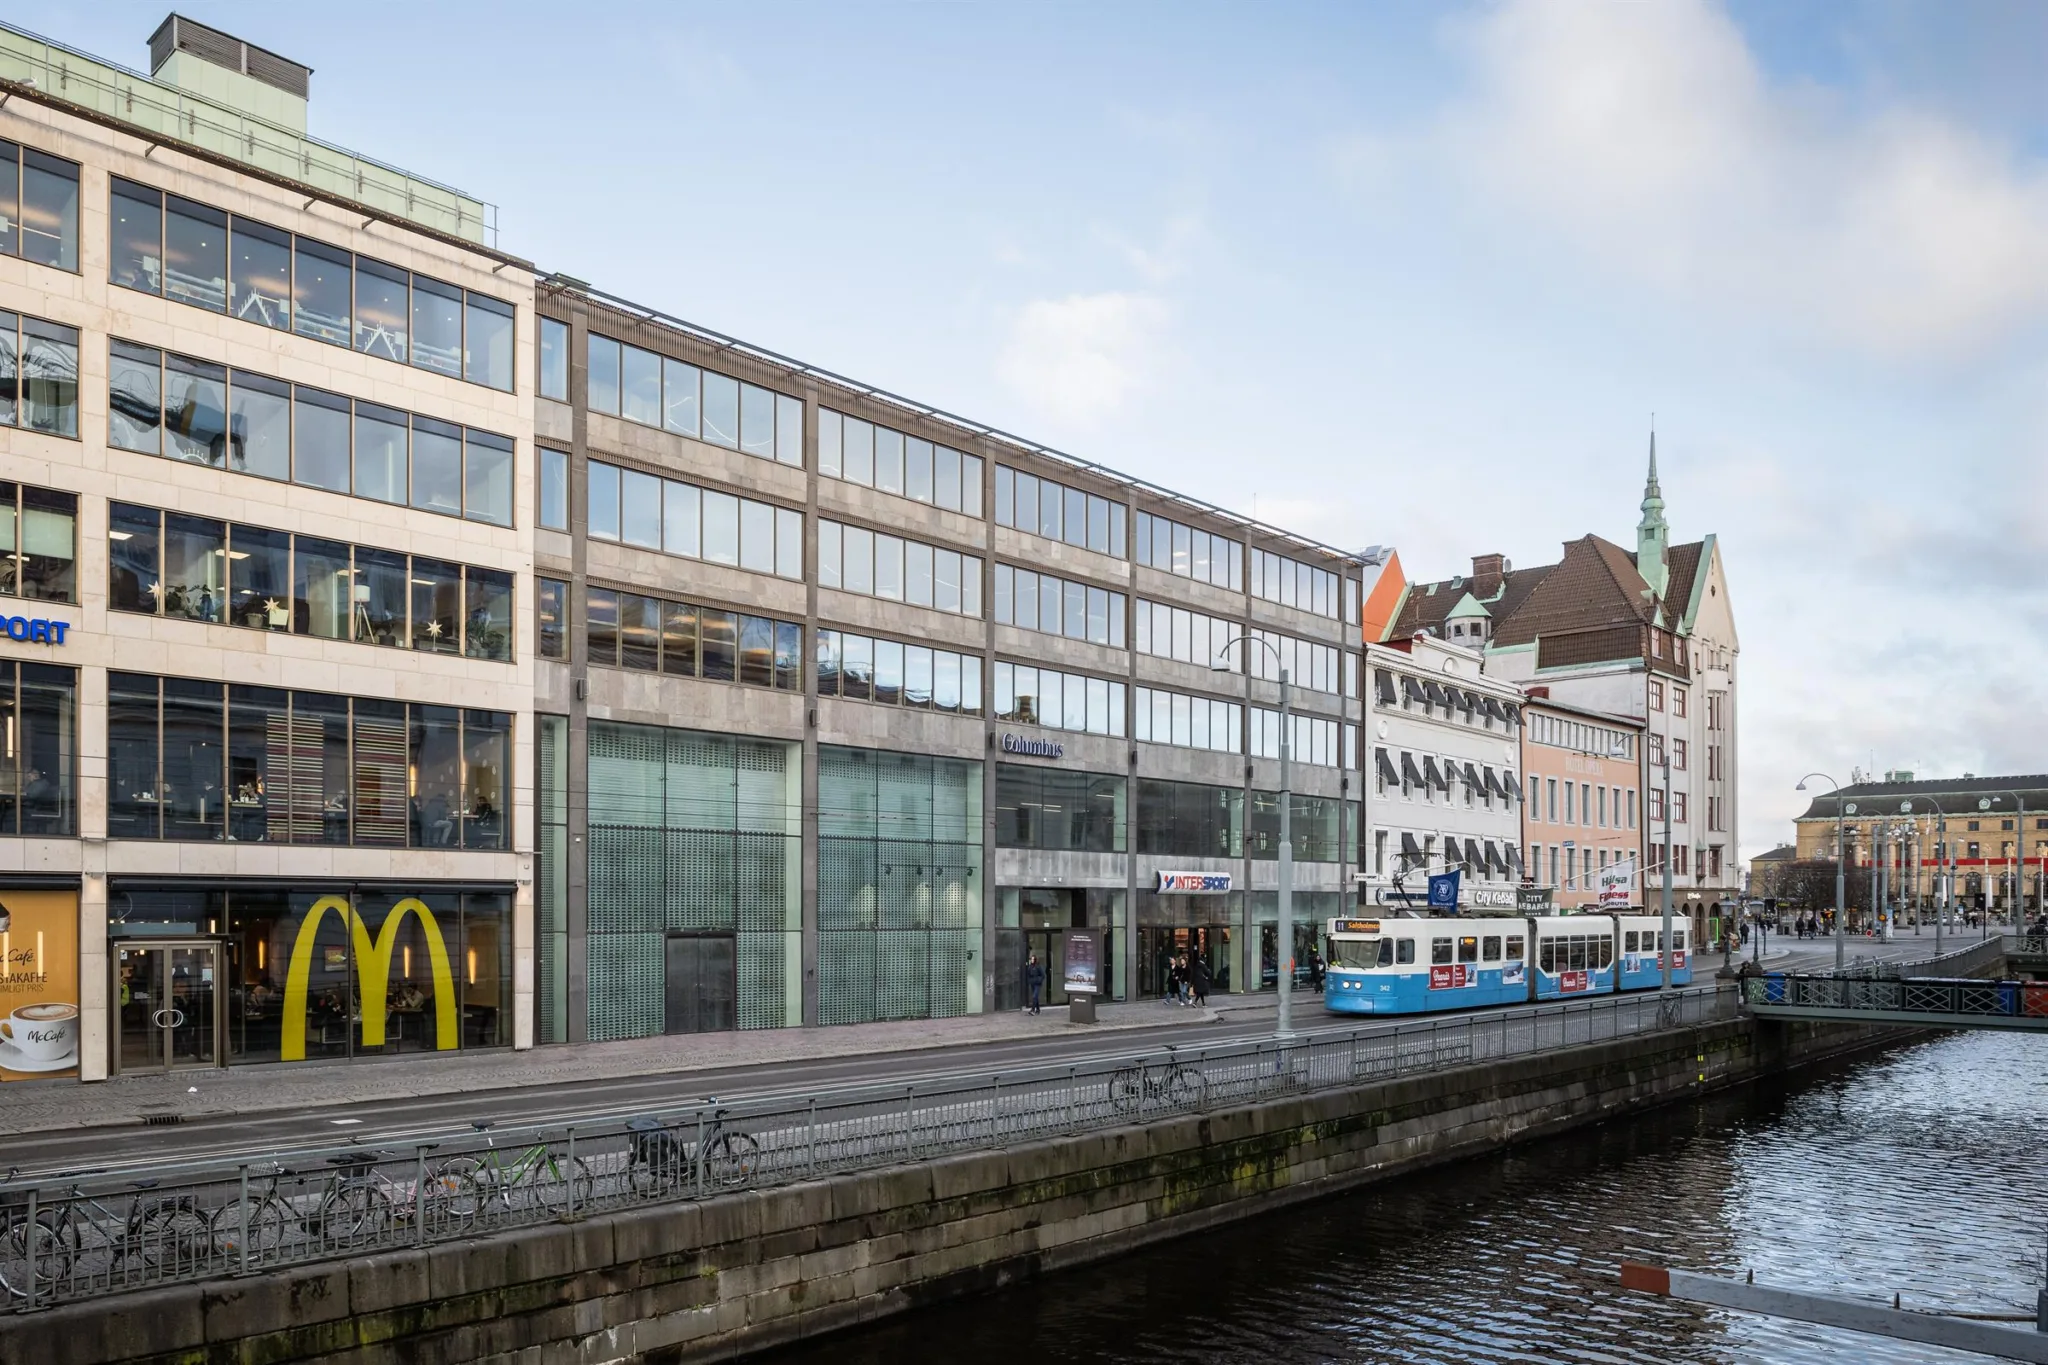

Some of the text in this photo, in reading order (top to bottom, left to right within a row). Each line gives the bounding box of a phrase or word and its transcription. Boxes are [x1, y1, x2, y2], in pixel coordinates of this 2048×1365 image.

[1003, 733, 1064, 757] Columbus
[1175, 875, 1231, 890] INTERSPORT
[1475, 890, 1514, 905] City Kebab
[1526, 894, 1543, 902] CITY
[1337, 922, 1344, 931] 11
[27, 983, 44, 992] PRIS
[27, 1027, 65, 1043] McCafé
